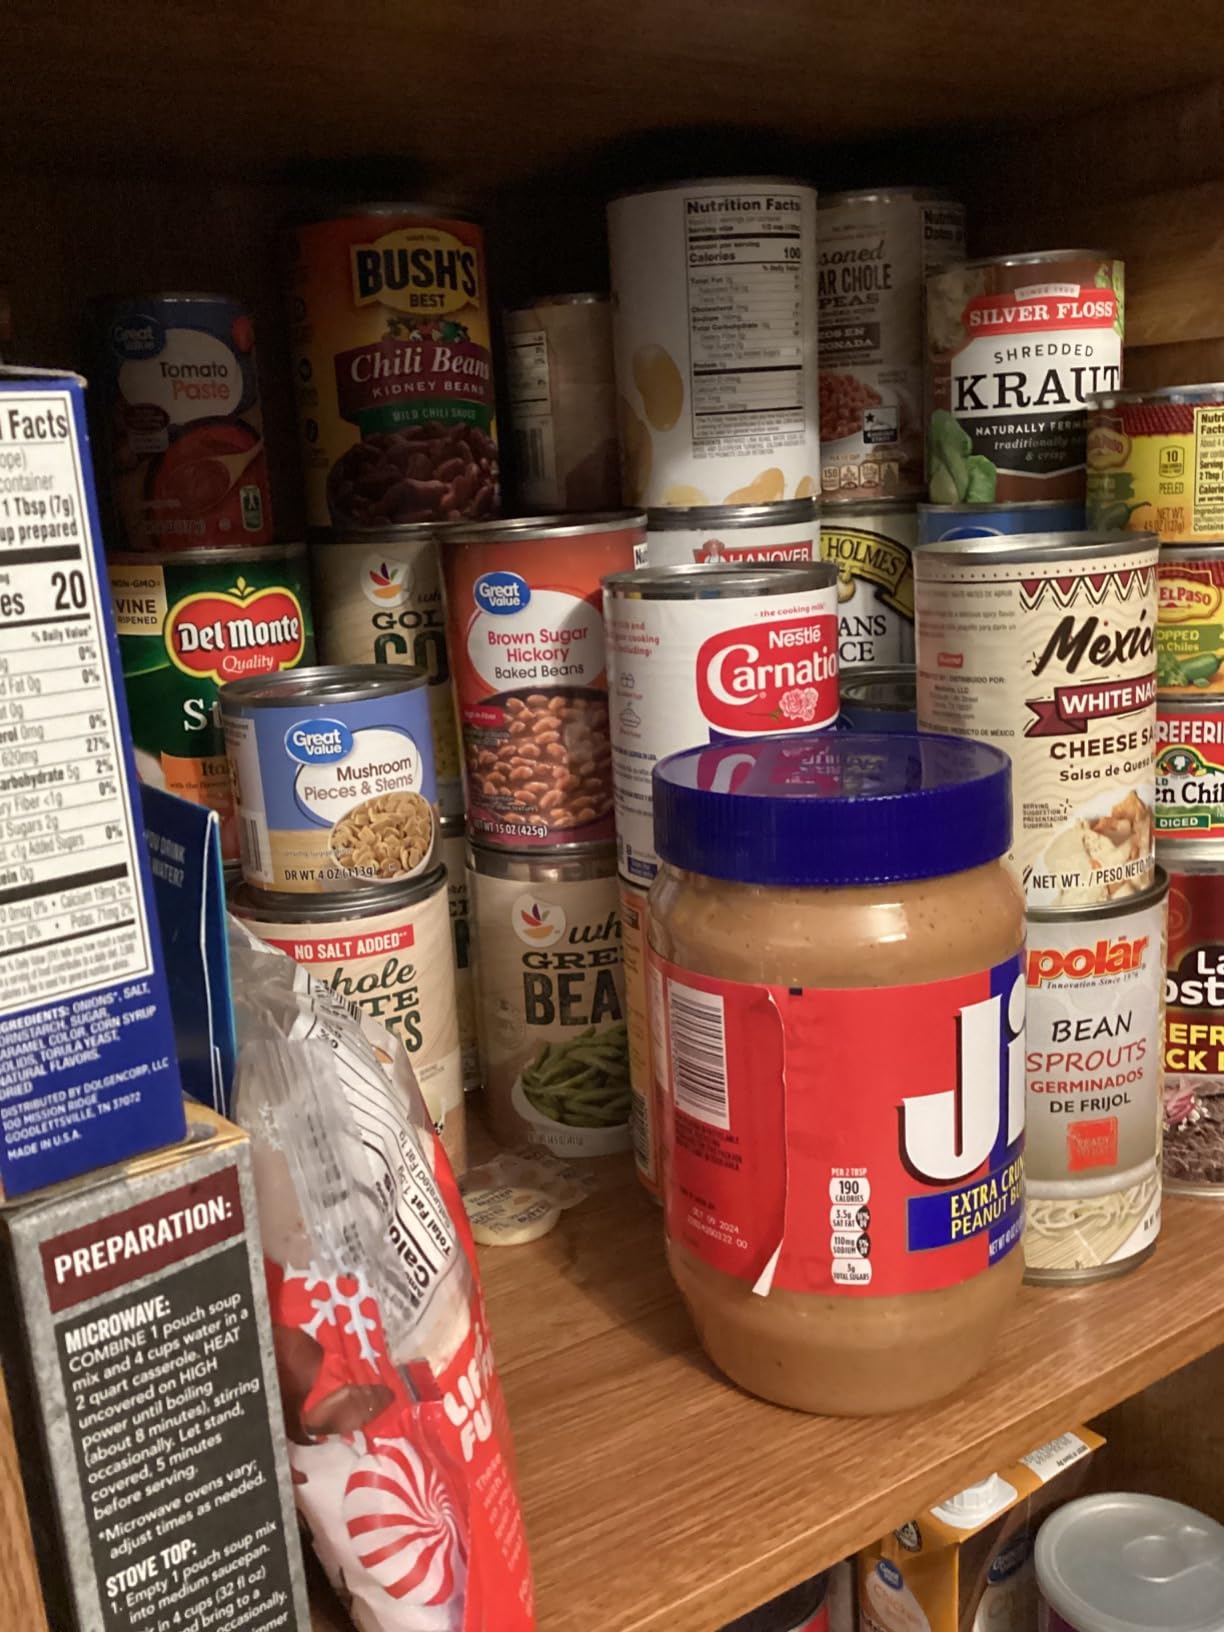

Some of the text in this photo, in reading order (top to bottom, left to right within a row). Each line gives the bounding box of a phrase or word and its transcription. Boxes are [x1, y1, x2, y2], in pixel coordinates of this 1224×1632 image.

[687, 198, 801, 214] Nutrition Facts
[689, 247, 801, 263] Calories 100
[356, 248, 477, 299] BUSH'S
[841, 263, 893, 293] CHOLE
[410, 293, 446, 308] BEST
[969, 300, 1113, 327] SILVER FLOSS
[351, 346, 422, 383] Chili
[994, 343, 1094, 364] SHREDDED
[159, 361, 229, 378] Tomato
[171, 380, 230, 400] Paste
[372, 381, 485, 399] KIDNEY BEANS
[954, 365, 1120, 412] KRAUT
[8, 408, 68, 440] Facts
[1201, 413, 1224, 423] Nutri
[975, 422, 1046, 437] NATURALLY
[1166, 450, 1178, 463] 10
[1159, 482, 1184, 495] PEELED
[15, 494, 75, 518] Tbsp (7g)
[1157, 508, 1171, 519] NET
[20, 521, 78, 545] prepared
[827, 538, 899, 577] HOLMES
[51, 569, 87, 611] 20
[479, 583, 520, 597] Great
[116, 599, 157, 614] VINE
[489, 596, 521, 607] Value
[760, 605, 810, 618] the cooking
[118, 616, 158, 626] RIPENED
[177, 615, 299, 651] Del Monte
[487, 627, 588, 646] Brown Sugar
[769, 625, 821, 649] Nestlé
[222, 654, 274, 674] Quality
[507, 648, 570, 663] Hickory
[495, 663, 584, 679] Baked Beans
[707, 646, 838, 706] Carnatio
[1062, 692, 1132, 714] WHITE
[86, 737, 111, 753] 27%
[292, 729, 341, 747] Great
[1050, 732, 1137, 760] CHEESE
[305, 743, 342, 756] Value
[96, 758, 113, 774] 2%
[336, 757, 412, 782] Mushroom
[1060, 758, 1150, 781] Salsa de Queso
[304, 772, 414, 801] Pieces & Stems
[495, 823, 548, 838] 15 OZ (425g)
[1160, 817, 1199, 828] DICED
[285, 864, 377, 881] DR WT 4 OZ (113g)
[1033, 860, 1144, 889] NET WT. PESO NETO
[295, 944, 313, 960] NO
[318, 942, 352, 959] SALT
[1047, 977, 1121, 990] Innovation Since
[522, 969, 623, 1027] BEA
[48, 1005, 157, 1047] COLOR, CORN SYRUP
[70, 1008, 110, 1028] SUGAR,
[1052, 1010, 1133, 1043] BEAN
[40, 1042, 83, 1064] TORULA
[1026, 1038, 1147, 1073] SPROUTS
[1, 1057, 169, 1119] DISTRIBUTED BY DOLGENCORP, LLC
[896, 974, 1026, 1187] Ji
[1030, 1068, 1144, 1094] GERMINADOS
[2, 1093, 98, 1131] 100 MISSION RIDGE
[1050, 1092, 1131, 1113] DE FRIJOL
[4, 1092, 141, 1144] GOODLETTSVILLE, TN 37072
[7, 1129, 82, 1160] MADE IN U.S.A.
[839, 1180, 860, 1195] 190
[951, 1179, 998, 1218] EXTRA
[835, 1195, 864, 1203] CALORIES
[833, 1219, 855, 1227] SAT FAT
[836, 1209, 851, 1219] 3.5g
[951, 1193, 1008, 1240] PEANUT
[410, 1195, 451, 1257] Total Fat
[719, 1220, 739, 1234] 2024
[54, 1195, 233, 1284] PREPARATION:
[833, 1246, 856, 1254] SODIUM
[834, 1236, 855, 1246] 110mg
[833, 1272, 870, 1280] TOTAL SUGARS
[64, 1294, 171, 1354] MICROWAVE:
[68, 1292, 241, 1373] COMBINE 1 pouch soup
[72, 1312, 237, 1393] mix and 4 cups water in
[75, 1327, 241, 1410] 2 quart casserole. HEAT
[78, 1357, 218, 1429] uncovered on HIGH
[93, 1464, 199, 1521] before serving.
[184, 1477, 225, 1504] ovens
[106, 1538, 197, 1598] STOVE TOP:
[157, 1545, 271, 1609] medium saucepan.
